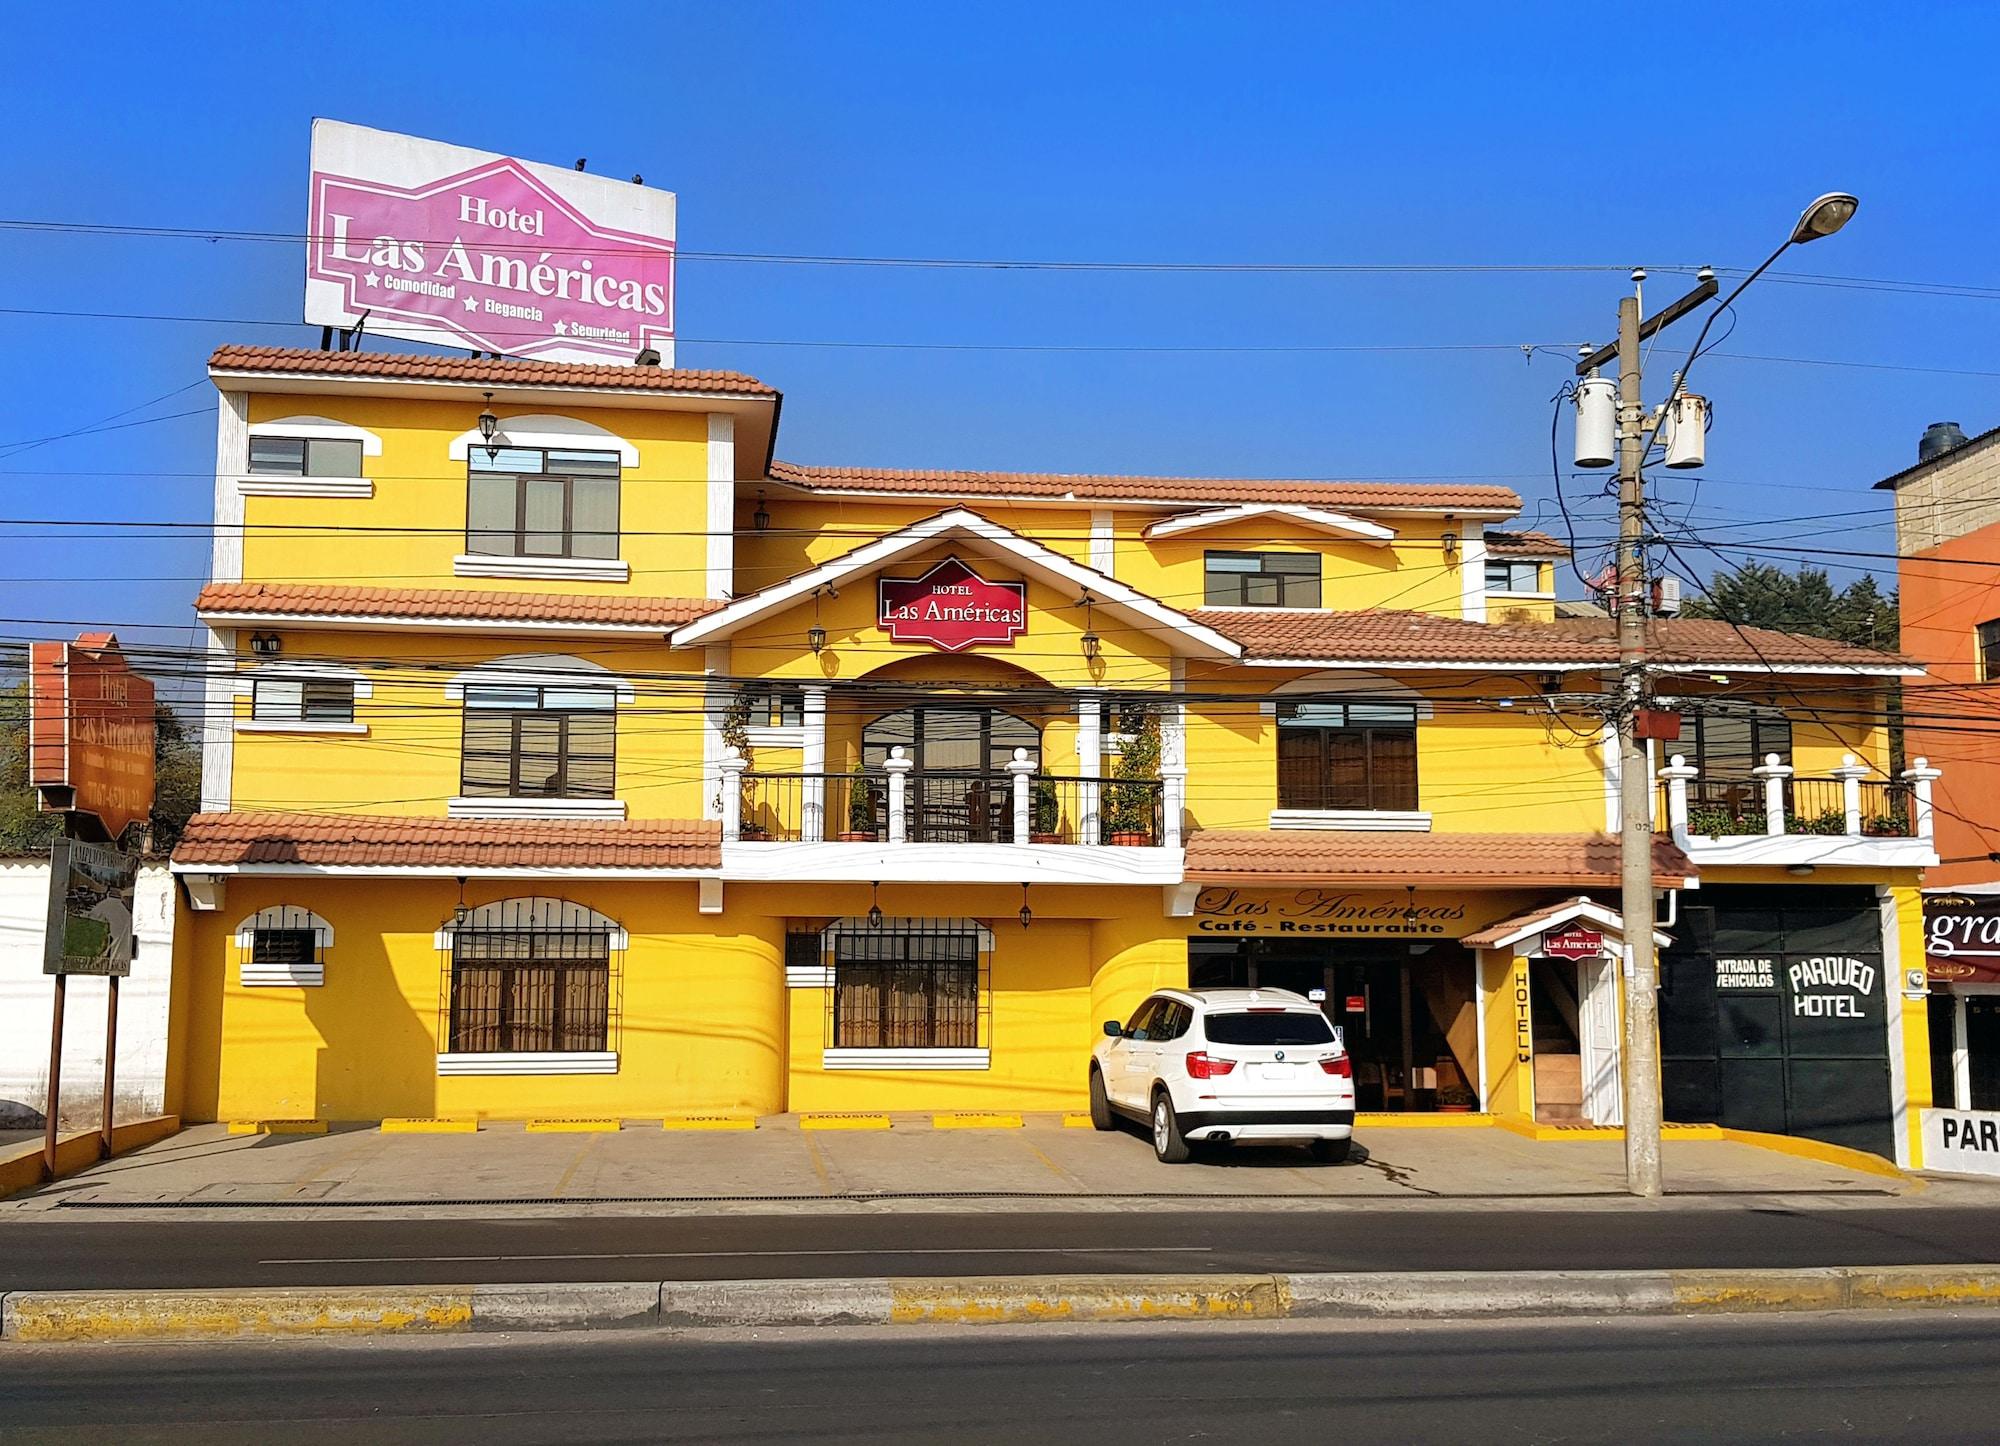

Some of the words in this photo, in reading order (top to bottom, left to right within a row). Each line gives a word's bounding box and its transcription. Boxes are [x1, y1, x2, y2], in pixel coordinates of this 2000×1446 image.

[457, 194, 545, 237] Hotel
[327, 212, 425, 274] Las
[432, 235, 666, 316] Américas
[384, 274, 456, 300] Comodidad
[484, 298, 543, 322] Elegancia
[571, 321, 630, 345] Seguridad
[932, 585, 973, 596] HOTEL
[883, 600, 919, 620] Las
[924, 601, 1021, 623] Américas
[100, 669, 128, 708] Hotel
[72, 700, 98, 745] Las
[1194, 886, 1270, 917] Las
[1279, 888, 1465, 920] Américas
[1198, 920, 1257, 931] Café
[1280, 921, 1445, 933] Restaurante
[1922, 914, 2000, 958] gra
[1547, 939, 1561, 949] Las
[1758, 959, 1772, 973] DE
[1788, 956, 1875, 996] PARQUEO
[1515, 973, 1529, 1048] HOTEL
[1794, 995, 1866, 1018] HOTEL
